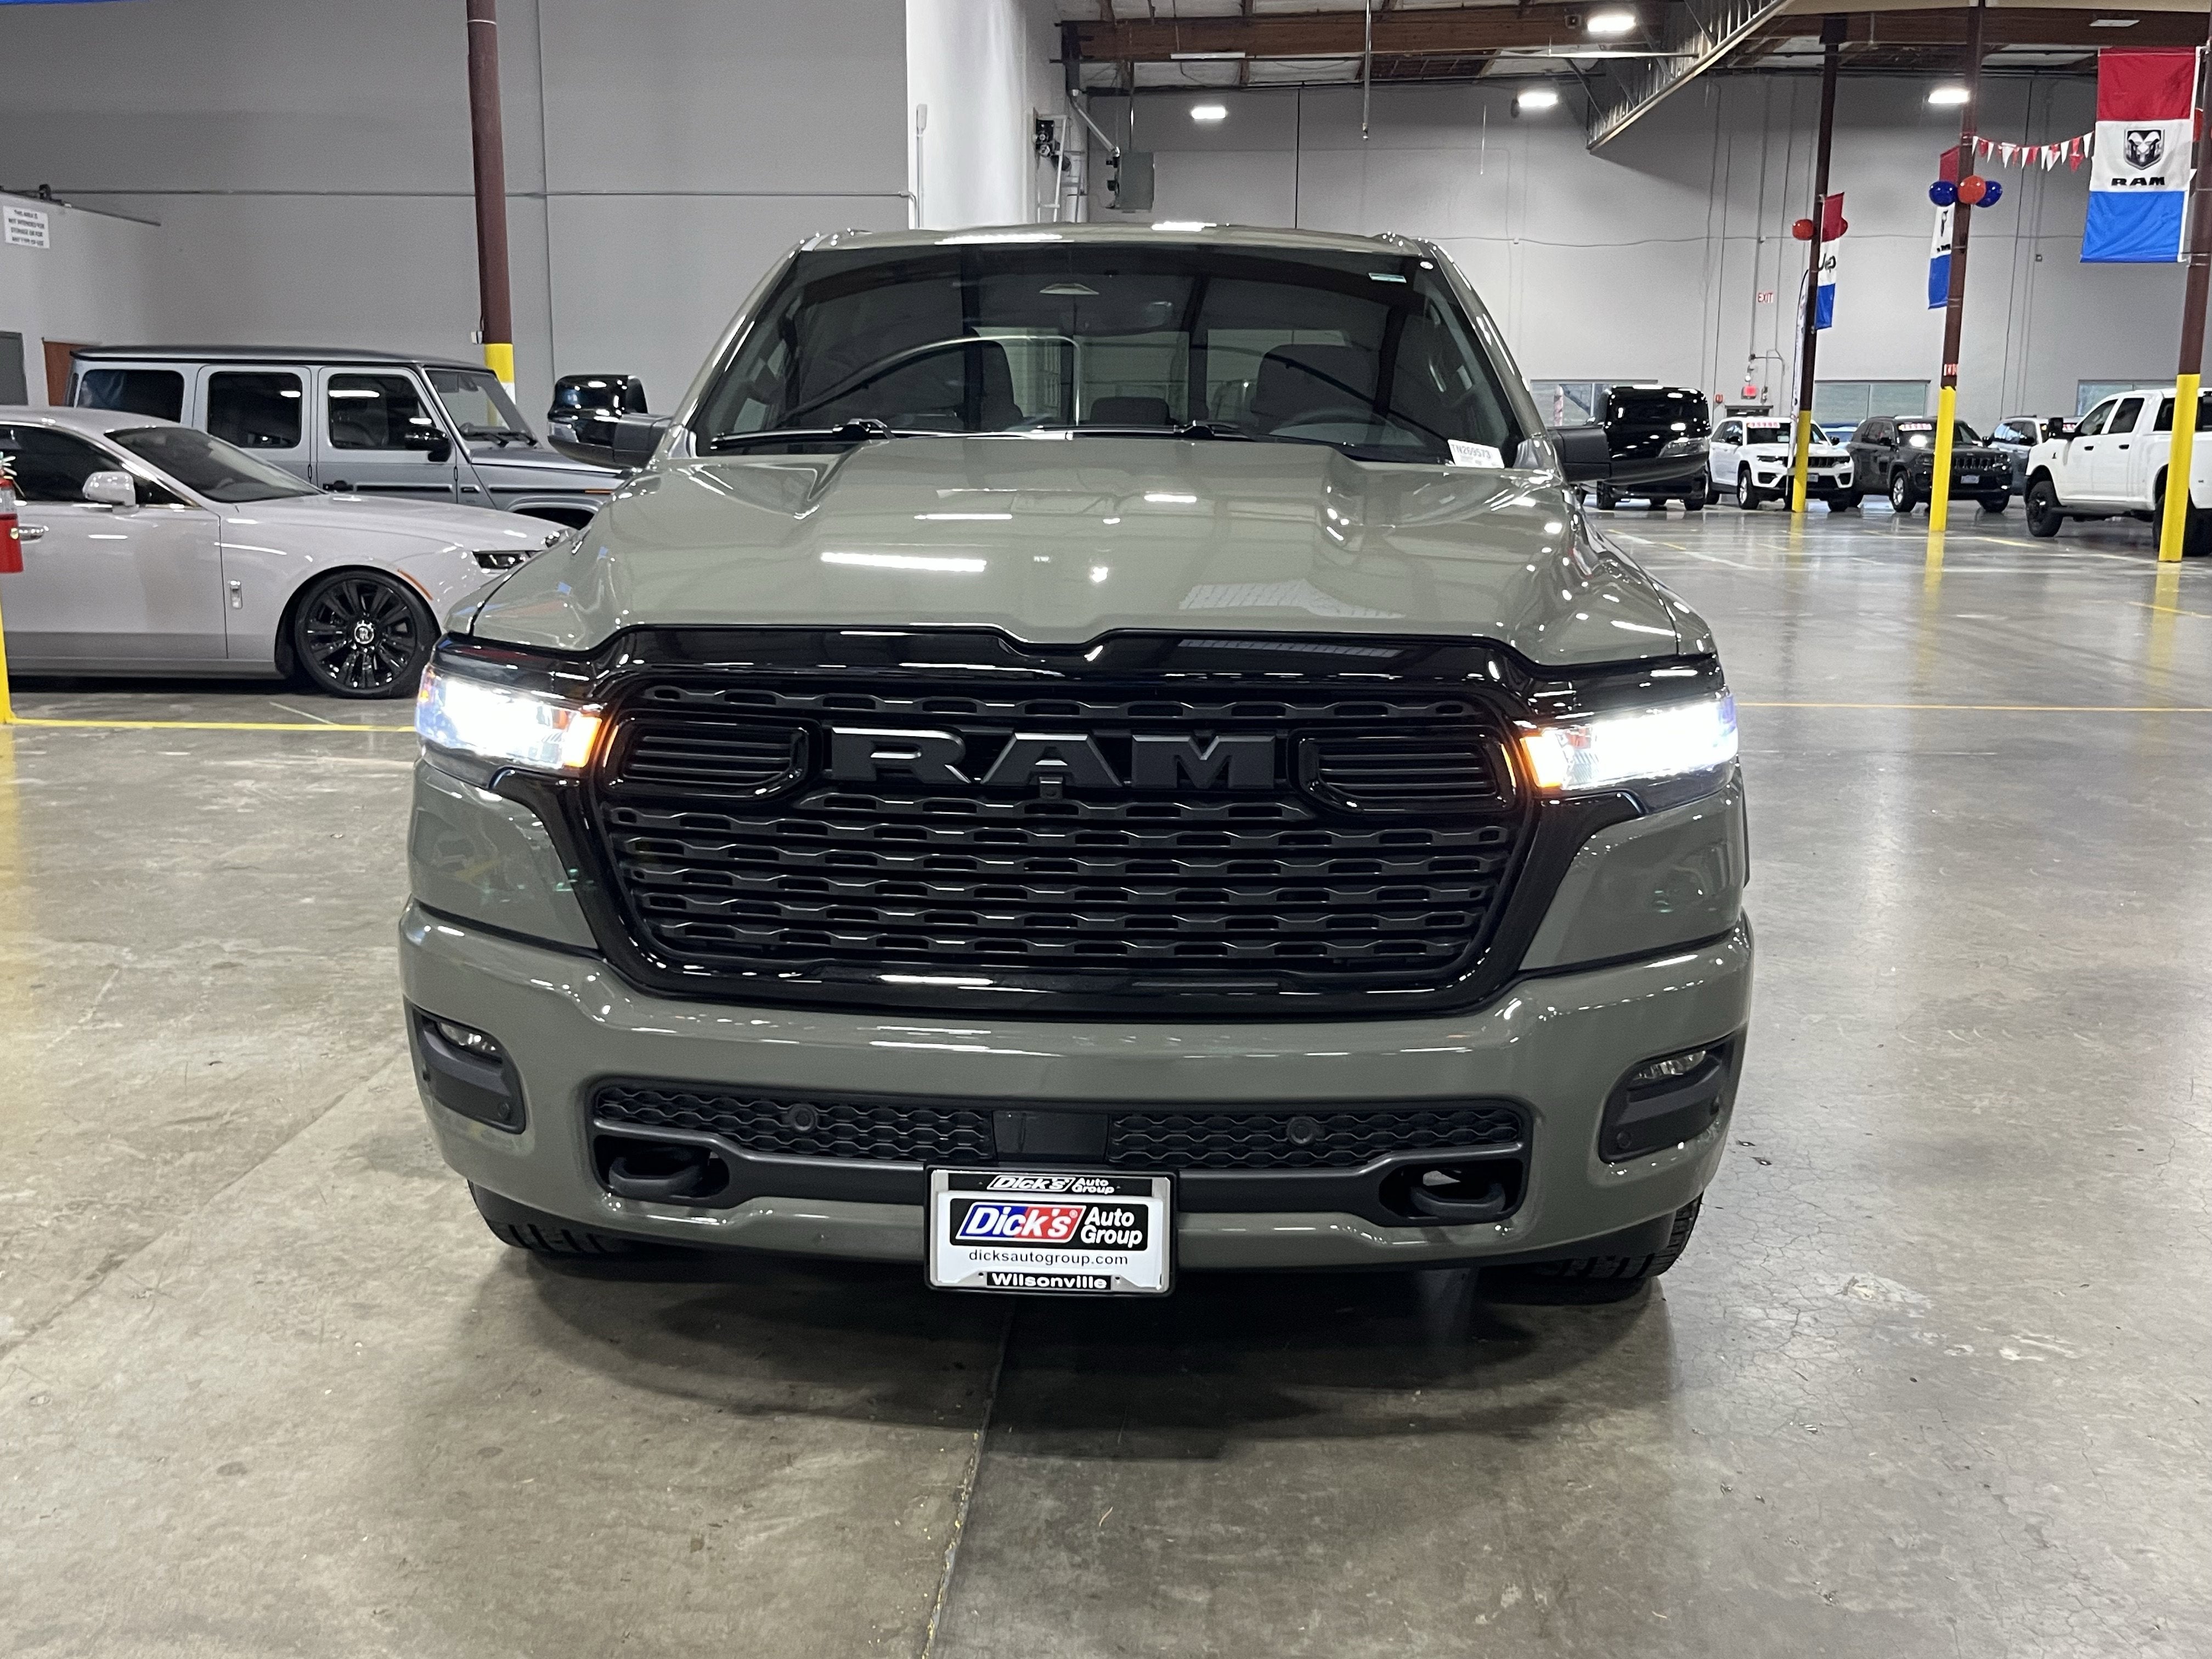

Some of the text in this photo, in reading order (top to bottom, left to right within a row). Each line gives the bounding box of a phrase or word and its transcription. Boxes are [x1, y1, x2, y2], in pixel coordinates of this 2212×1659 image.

[2111, 177, 2165, 186] RAM
[1757, 292, 1773, 303] EXIT
[832, 727, 1276, 788] RAM
[1071, 1184, 1115, 1195] Group
[1075, 1177, 1109, 1187] Auto
[1084, 1206, 1135, 1227] Auto
[1080, 1225, 1143, 1248] Group
[969, 1249, 1128, 1266] dicksautogroup.com
[991, 1272, 1107, 1289] Wilsonville
